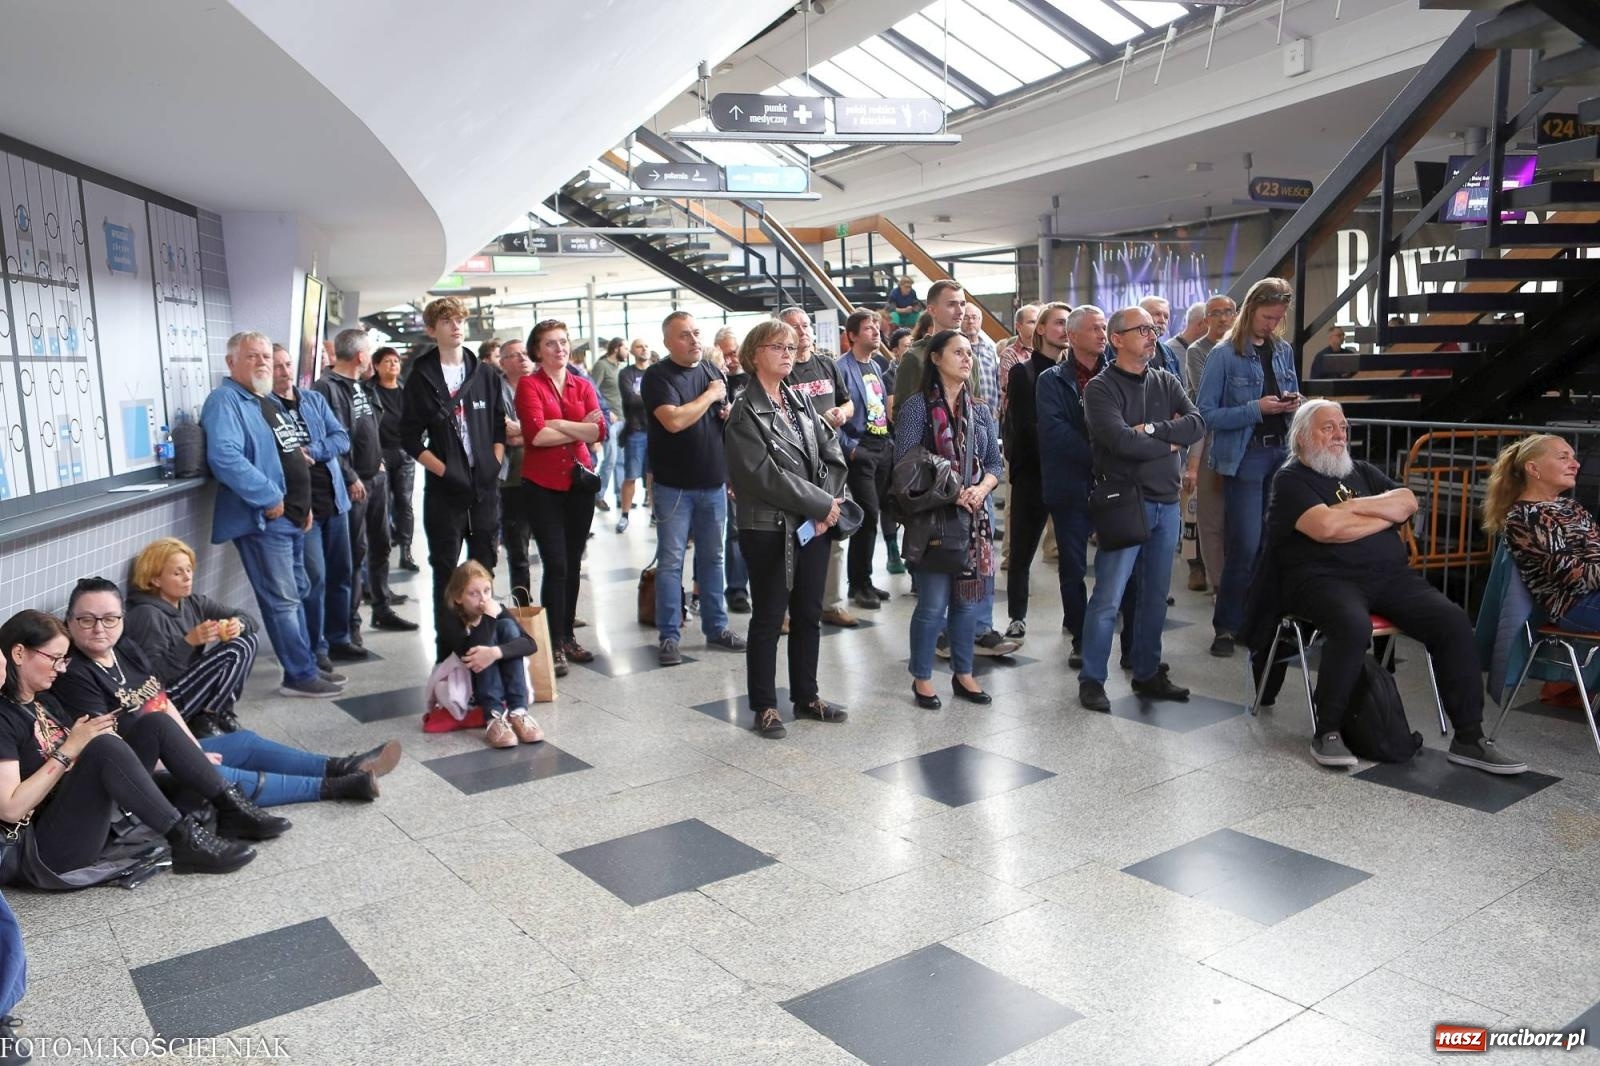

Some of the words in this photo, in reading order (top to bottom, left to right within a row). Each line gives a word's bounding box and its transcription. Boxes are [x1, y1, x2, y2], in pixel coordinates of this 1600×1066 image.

[763, 103, 787, 115] punkt
[749, 113, 787, 126] medyczny
[1551, 119, 1574, 138] 24
[1261, 181, 1280, 196] 23
